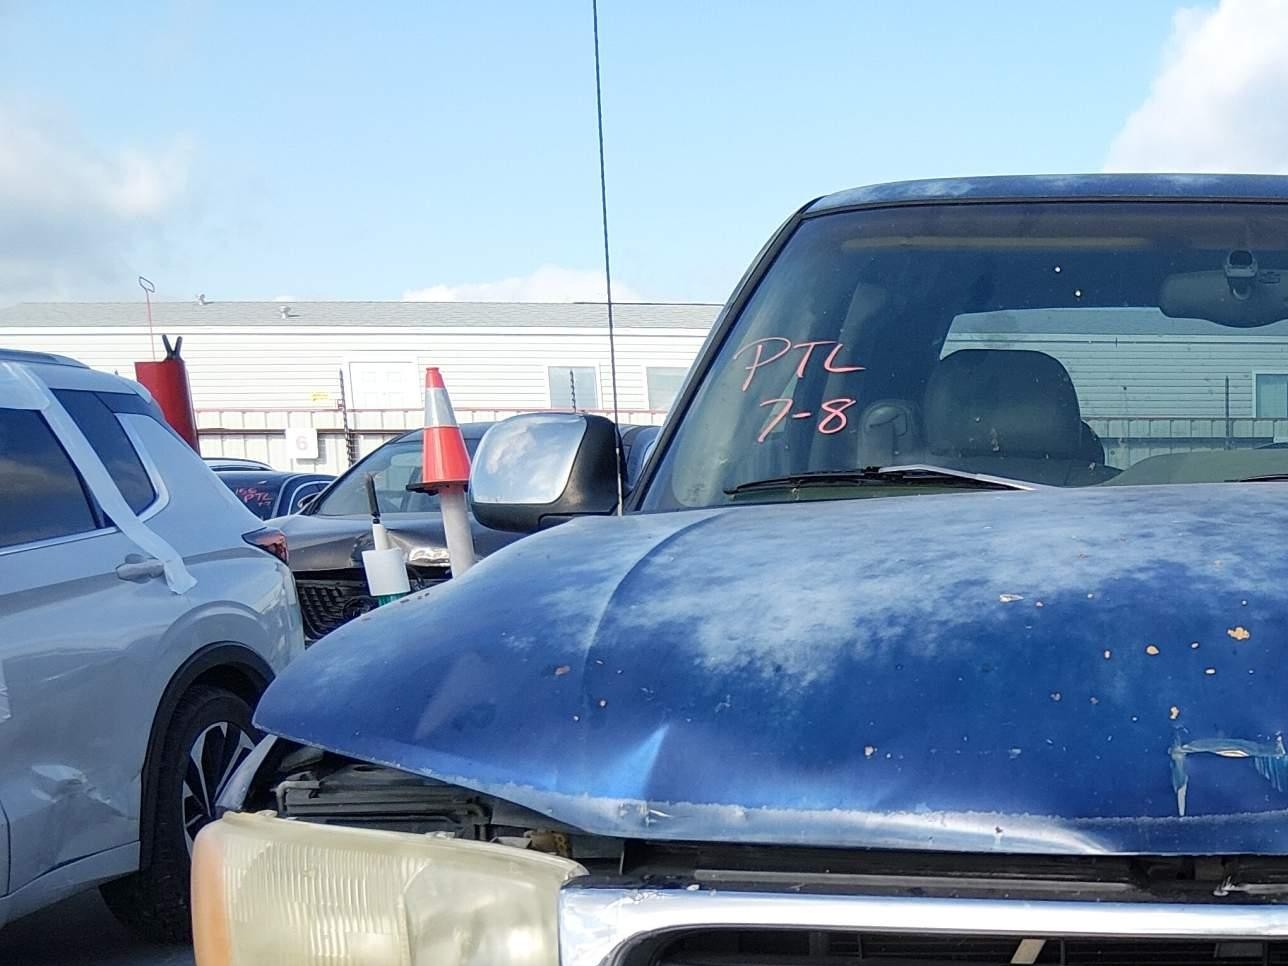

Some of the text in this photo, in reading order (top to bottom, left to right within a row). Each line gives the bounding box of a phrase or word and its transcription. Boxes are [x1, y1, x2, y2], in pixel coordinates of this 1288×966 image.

[733, 337, 866, 392] PTL
[296, 435, 309, 451] 6
[757, 398, 857, 443] 7-8
